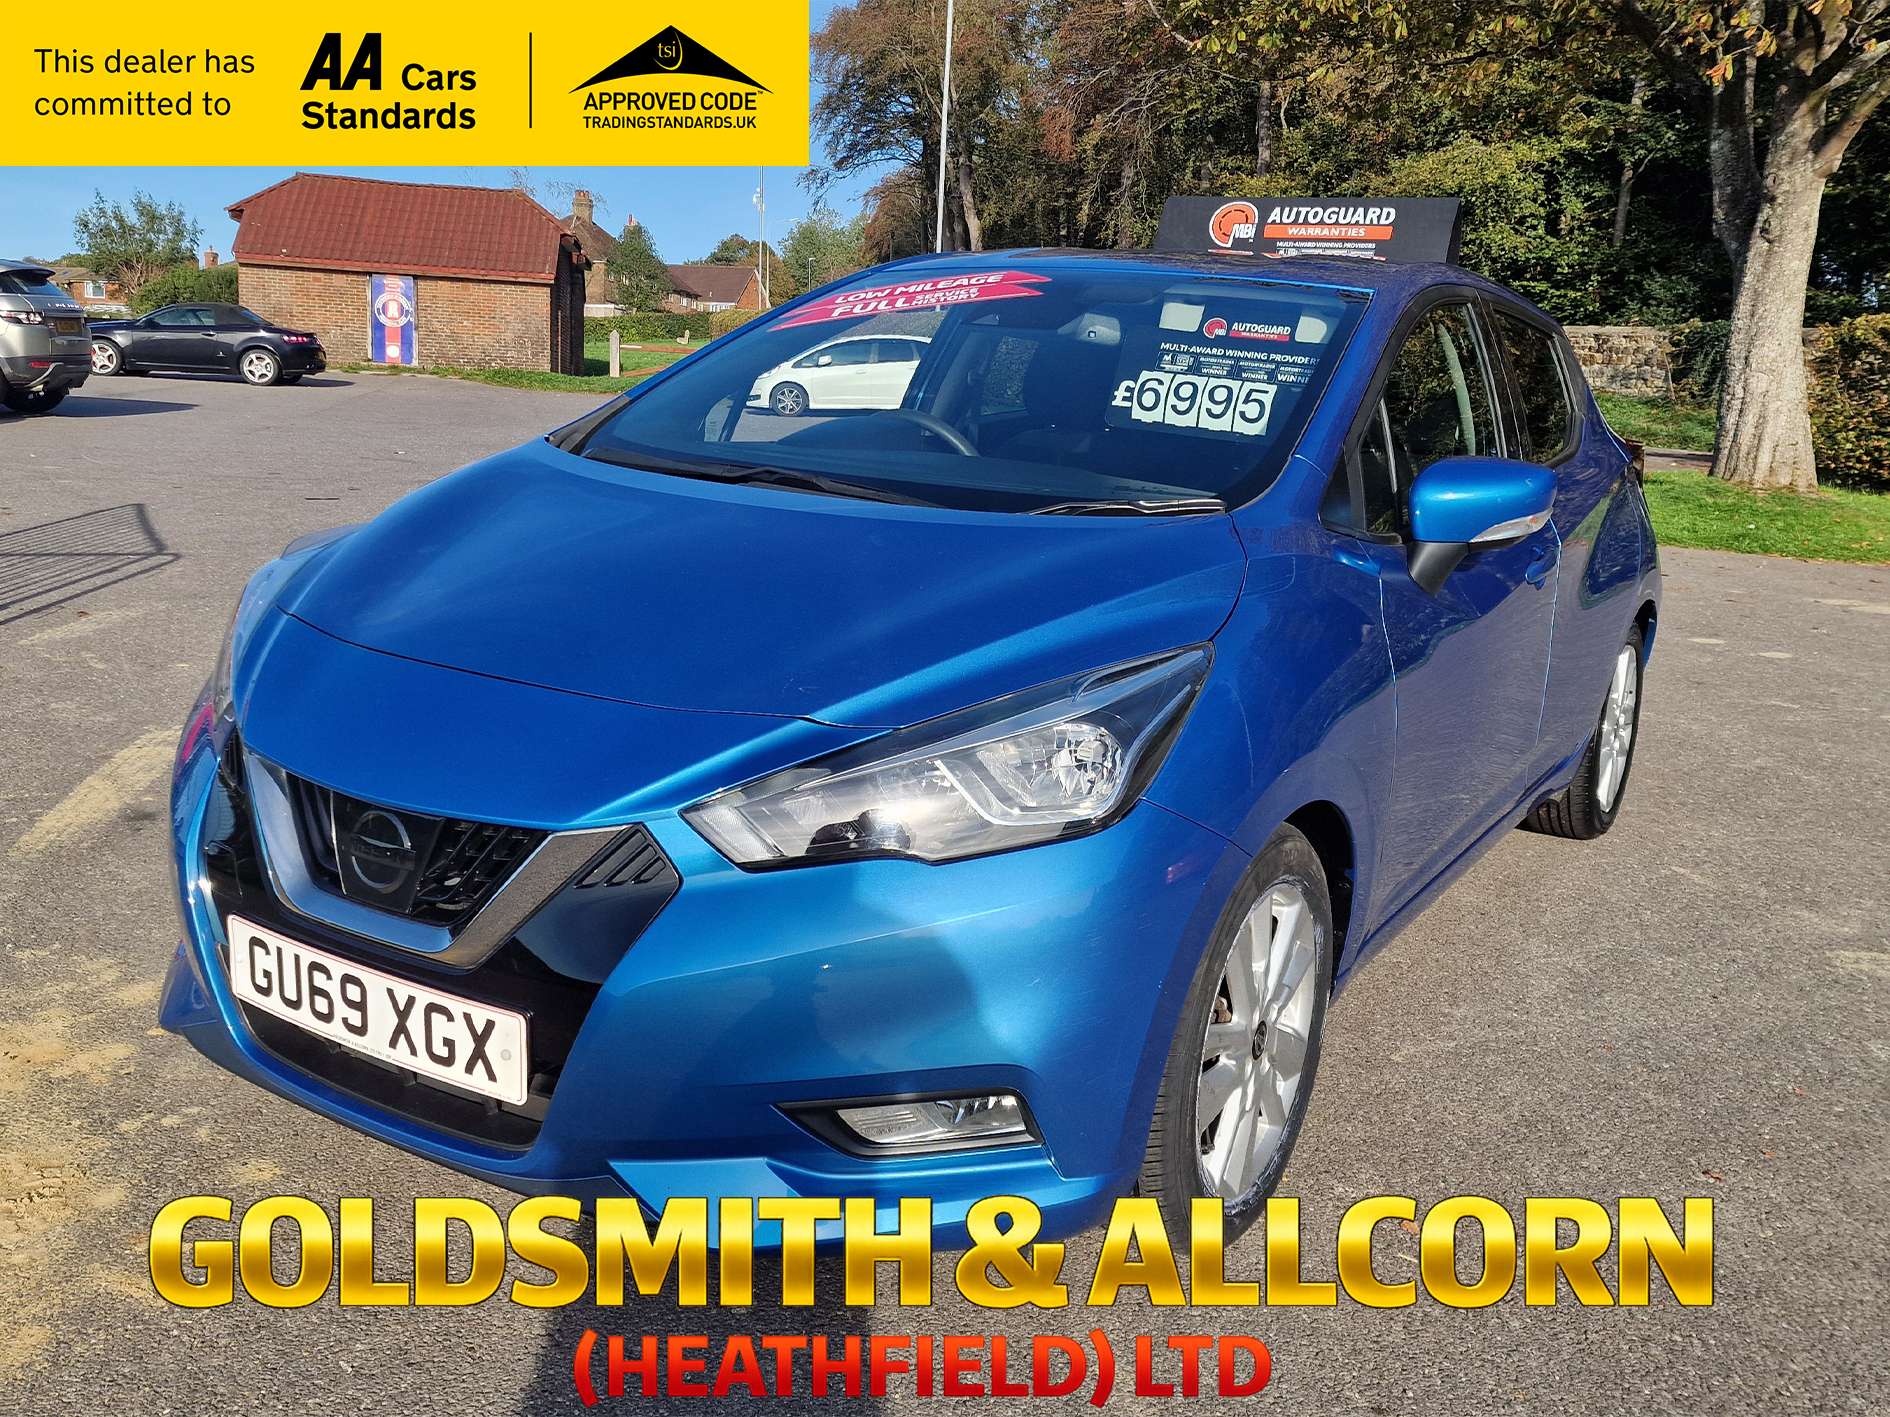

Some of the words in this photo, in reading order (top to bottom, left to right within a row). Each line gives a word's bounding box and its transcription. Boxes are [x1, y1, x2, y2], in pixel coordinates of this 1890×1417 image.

[1266, 206, 1396, 225] AUTOGUARD
[1287, 227, 1366, 237] WARRANTIES
[834, 289, 891, 304] LOW
[894, 274, 1005, 295] MILEAGE
[831, 297, 910, 317] FULL
[915, 287, 979, 300] SERVICE
[911, 292, 979, 306] HISTORY
[1231, 322, 1291, 335] AUTOGUARD
[1160, 342, 1224, 356] MULTI-AWARD
[1225, 350, 1268, 361] WINNING
[1201, 367, 1228, 376] WINNER
[1241, 372, 1268, 380] WINNER
[1112, 376, 1271, 425] £6995
[248, 935, 369, 1038] GU69
[386, 987, 498, 1083] XGX
